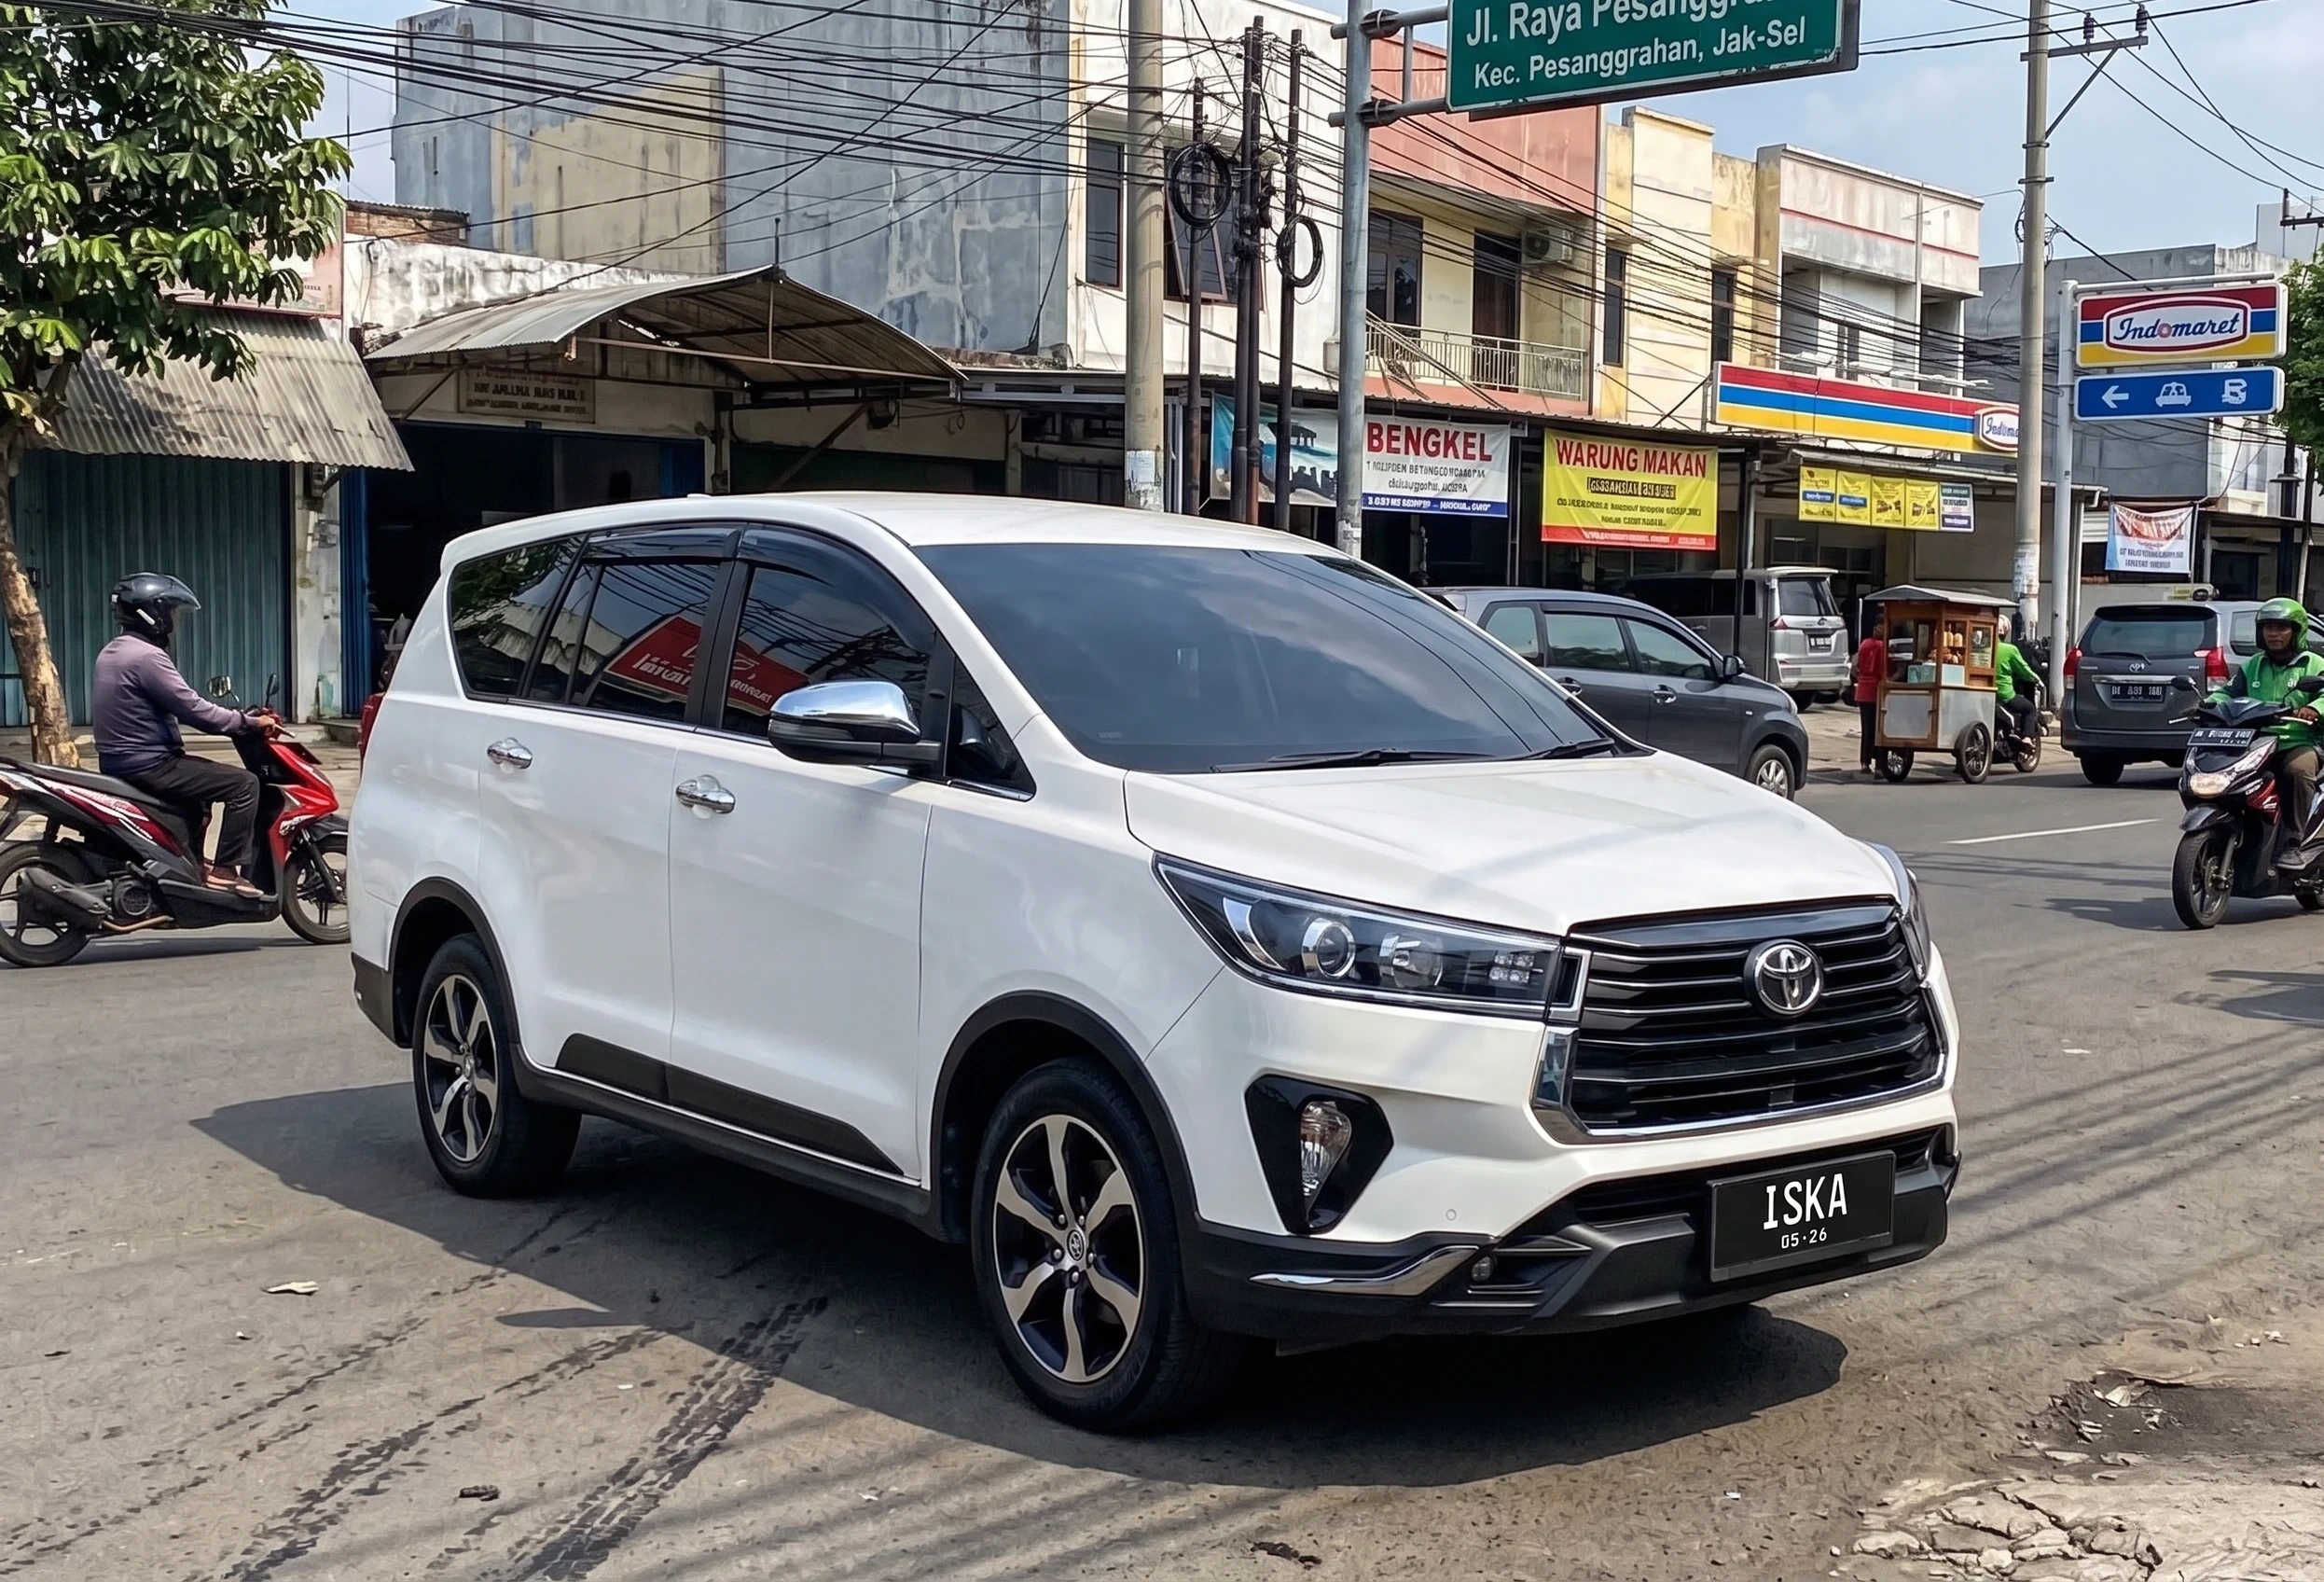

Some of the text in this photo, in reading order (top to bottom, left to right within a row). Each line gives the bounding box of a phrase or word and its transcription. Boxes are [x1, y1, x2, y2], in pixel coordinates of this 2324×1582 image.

[1466, 7, 1498, 47] Jl.
[1509, 2, 1582, 45] Raya
[1474, 16, 1805, 89] Kec. Pesanggrahan, Jak-Sel
[2112, 312, 2240, 341] Indomaret
[1366, 423, 1492, 462] BENGKEL
[1555, 438, 1707, 479] WARUNG MAKAN
[1763, 1173, 1847, 1230] ISKA
